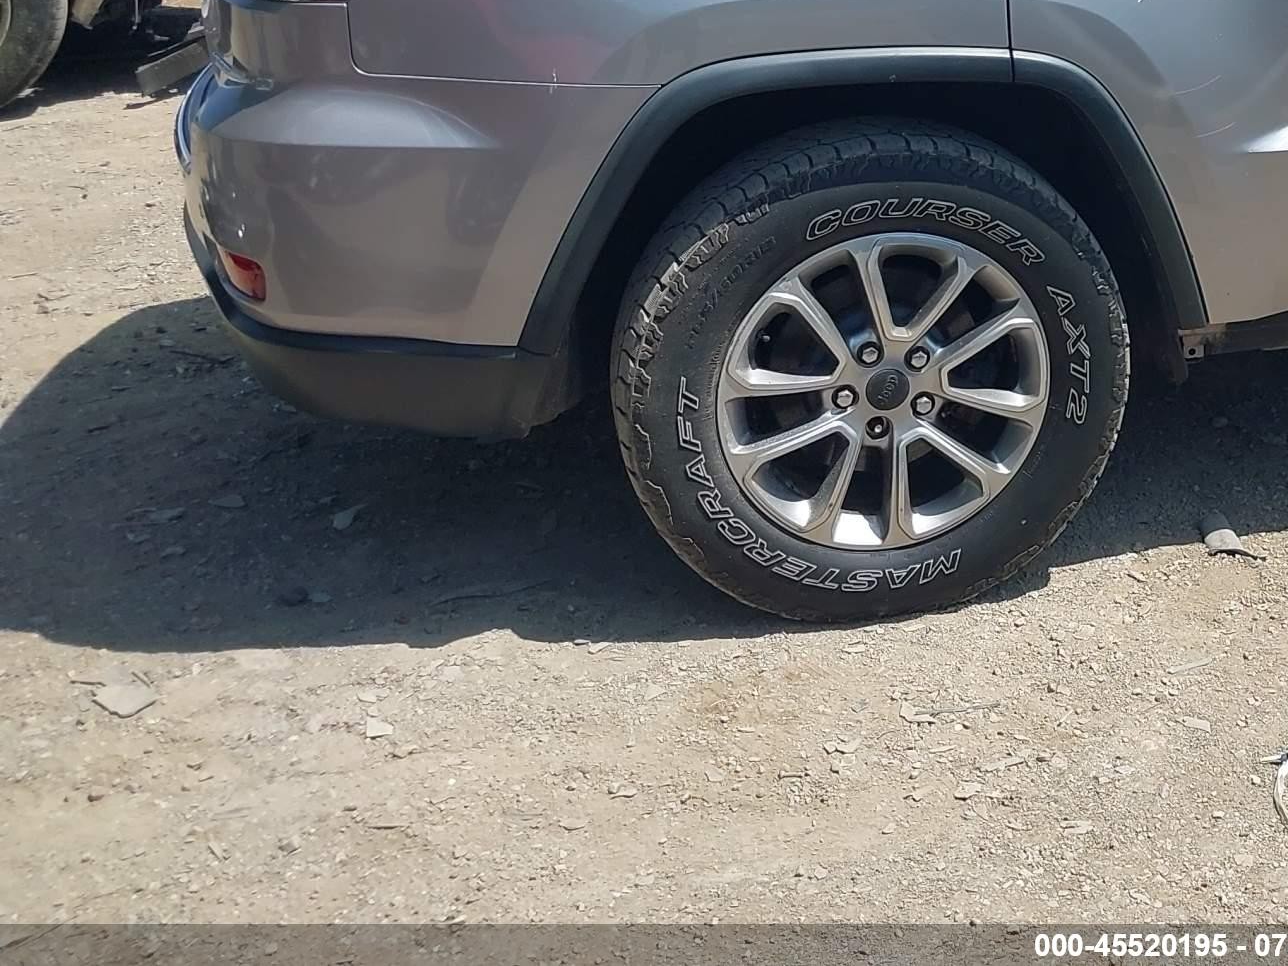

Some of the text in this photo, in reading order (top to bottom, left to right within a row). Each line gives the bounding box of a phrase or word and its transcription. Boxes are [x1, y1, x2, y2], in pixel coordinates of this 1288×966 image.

[806, 197, 1091, 425] COURSER AXT2
[676, 376, 962, 593] MASTERCRAFT
